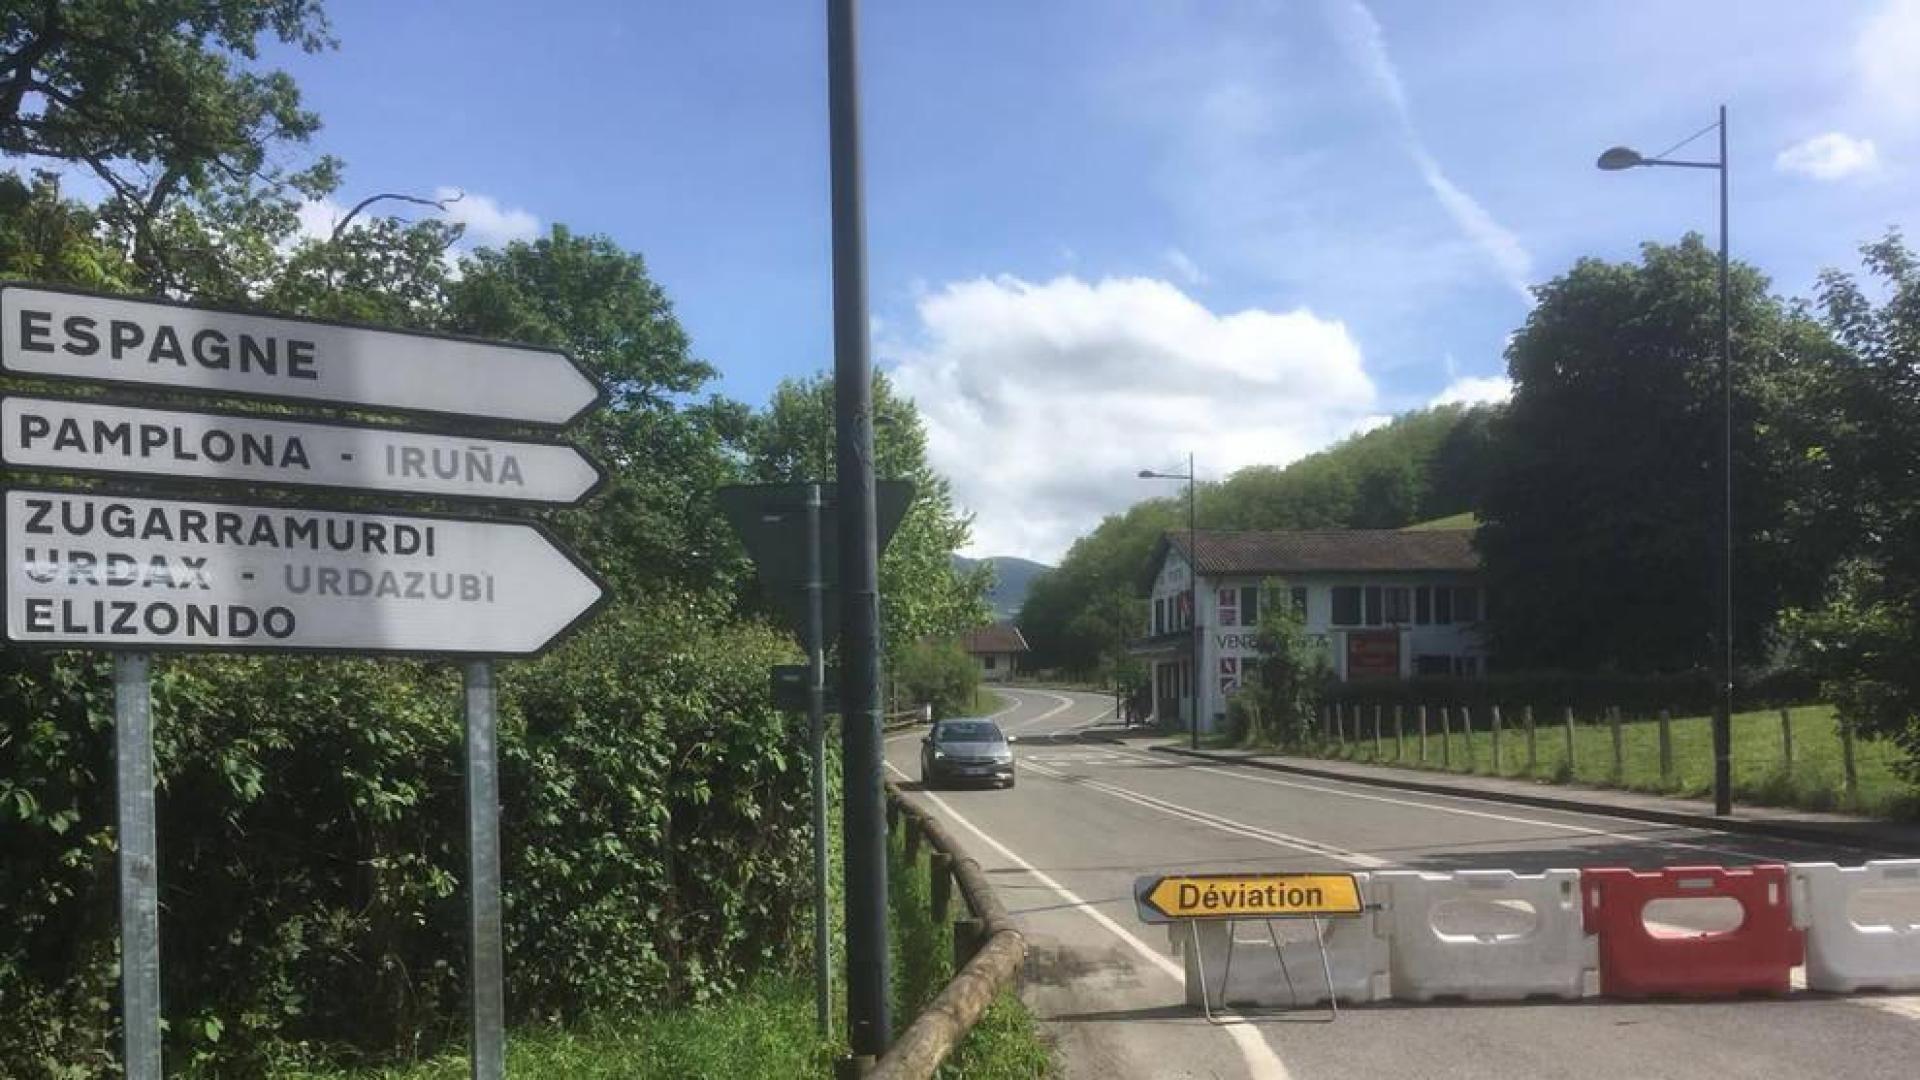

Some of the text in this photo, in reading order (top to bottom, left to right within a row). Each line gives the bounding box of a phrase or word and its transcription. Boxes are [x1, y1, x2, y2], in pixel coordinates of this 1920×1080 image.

[20, 309, 319, 381] ESPAGNE
[20, 414, 311, 471] PAMPLONA
[386, 445, 524, 486] IRUÑA
[25, 500, 435, 556] ZUGARRAMURDI
[25, 547, 211, 590] URDAX
[284, 564, 495, 603] URDAZUBI
[25, 599, 296, 639] ELIZONDO
[1178, 883, 1323, 910] Déviation
